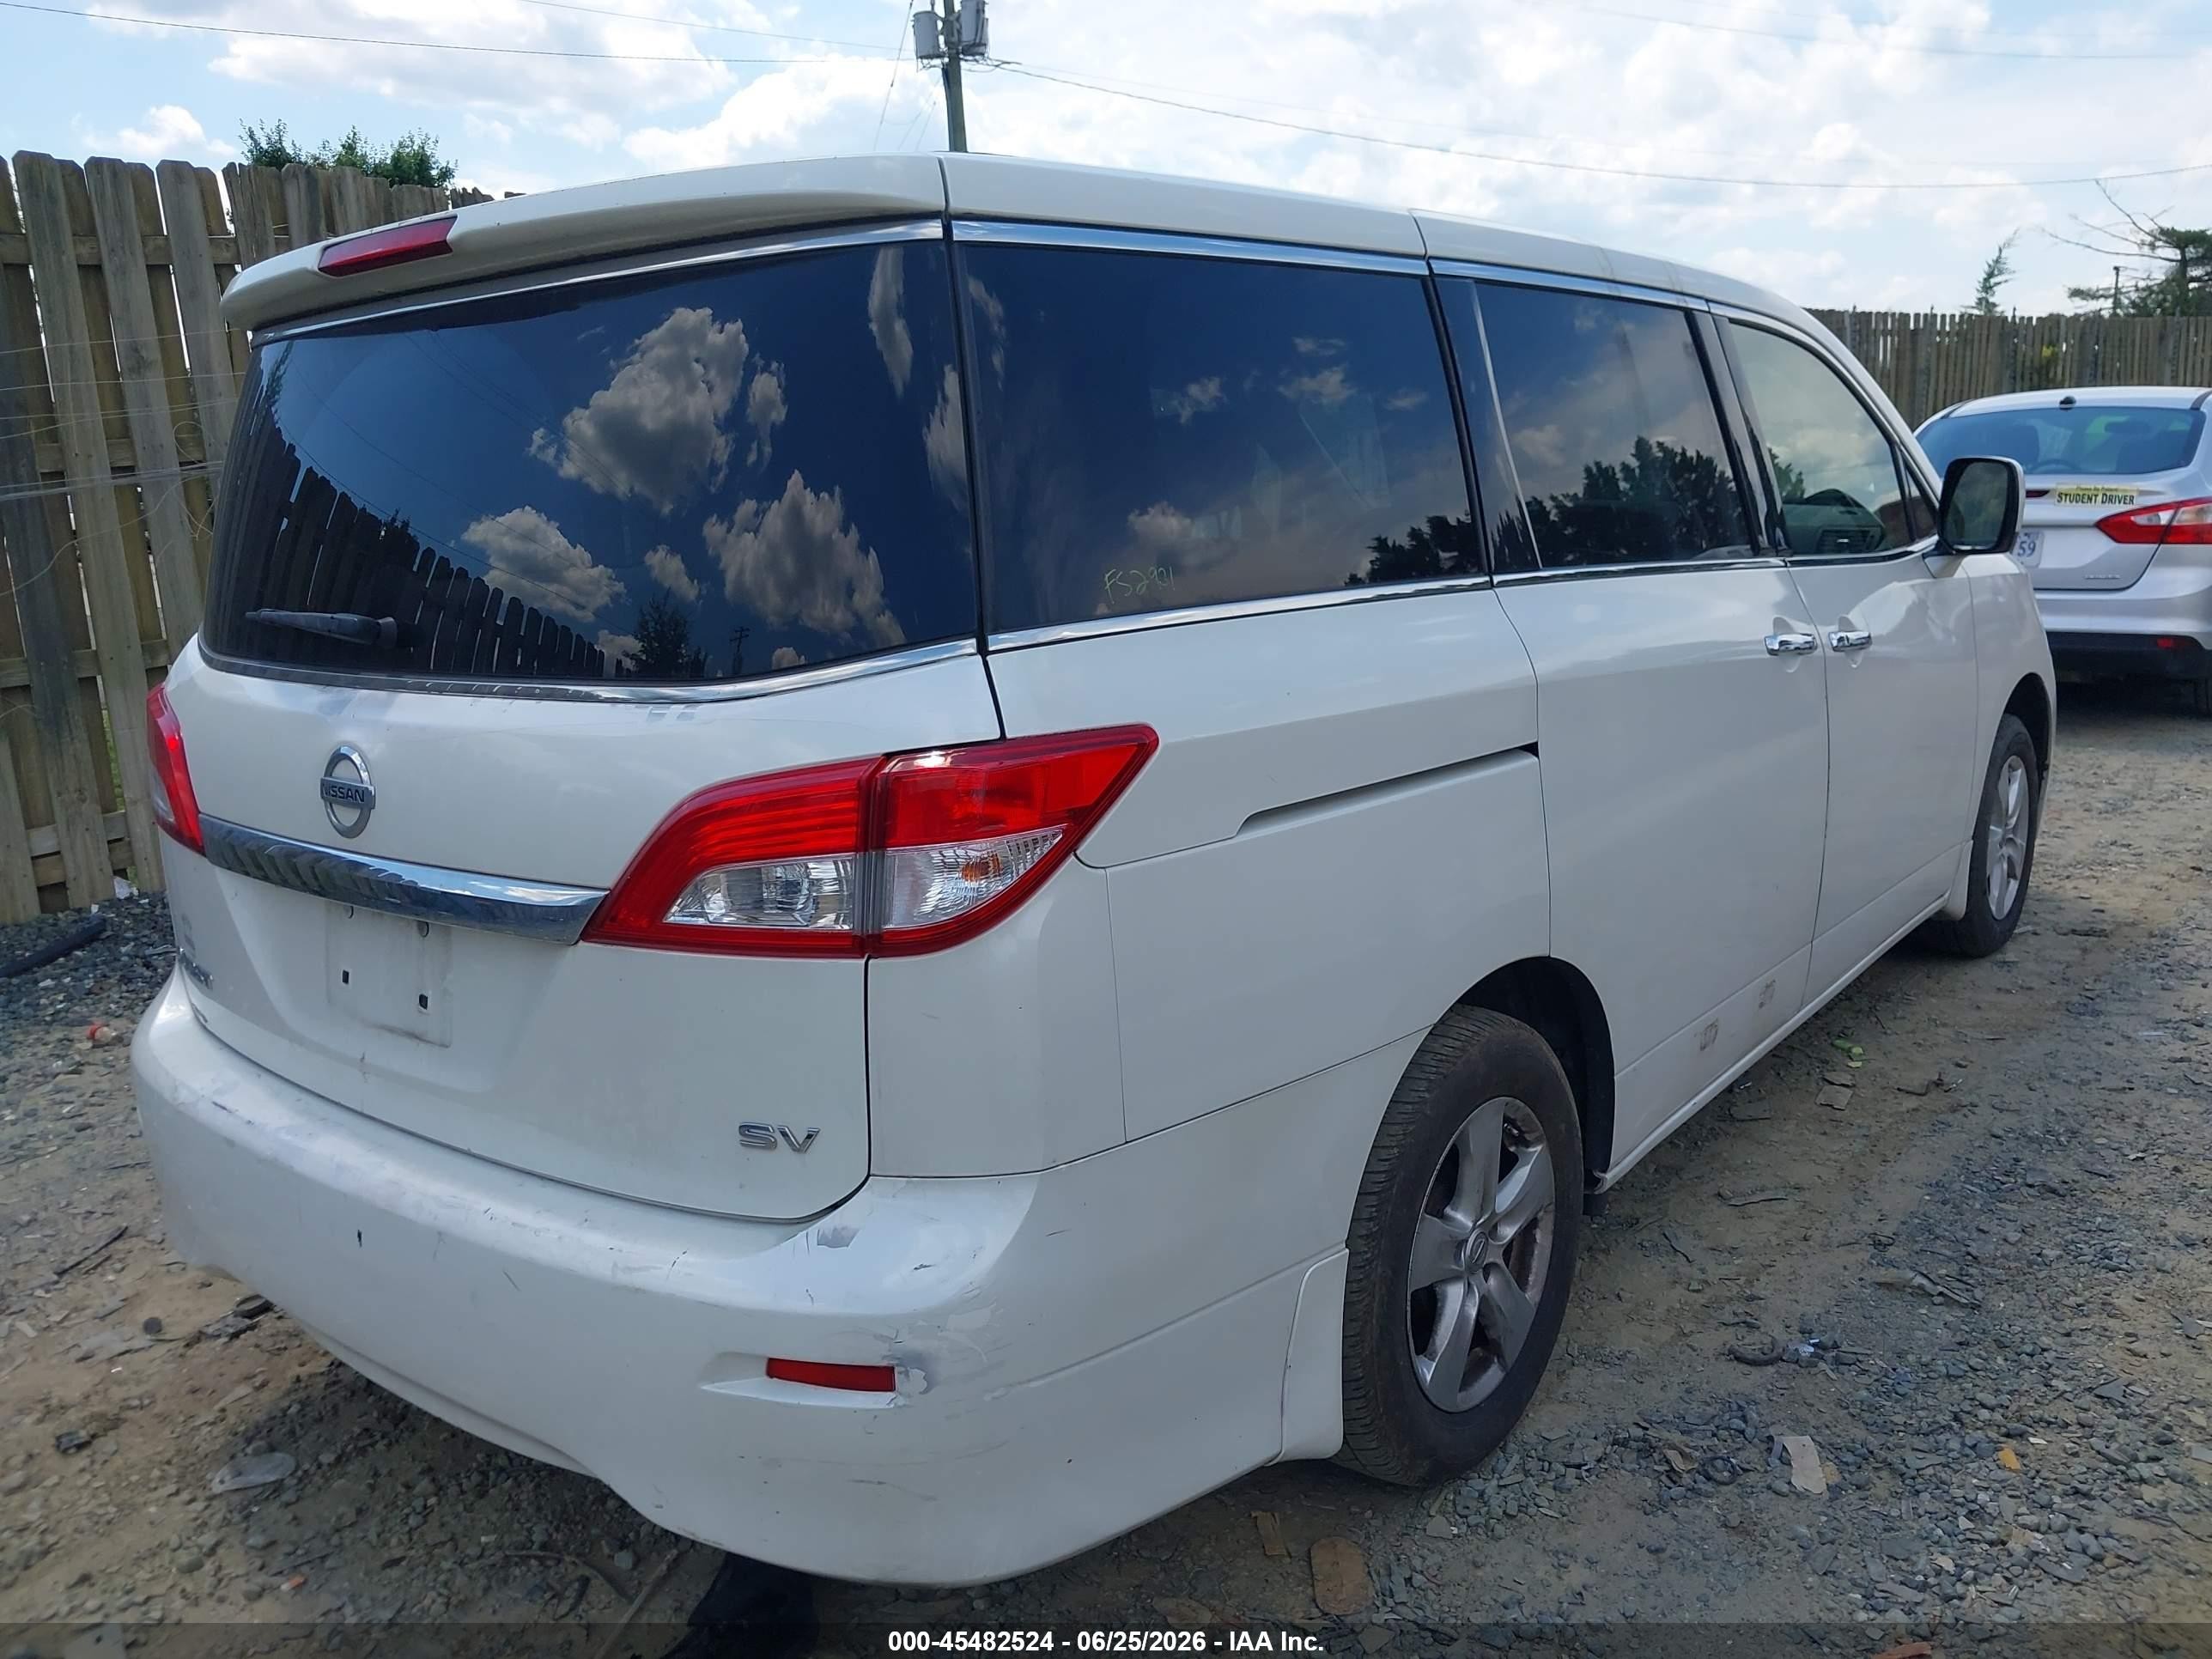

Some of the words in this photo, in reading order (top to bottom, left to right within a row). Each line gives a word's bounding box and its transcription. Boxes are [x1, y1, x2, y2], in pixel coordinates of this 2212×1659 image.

[2057, 492, 2099, 505] STUDENT
[2100, 493, 2135, 505] DRIVER
[322, 782, 366, 803] NISSAN
[738, 1121, 821, 1153] SV
